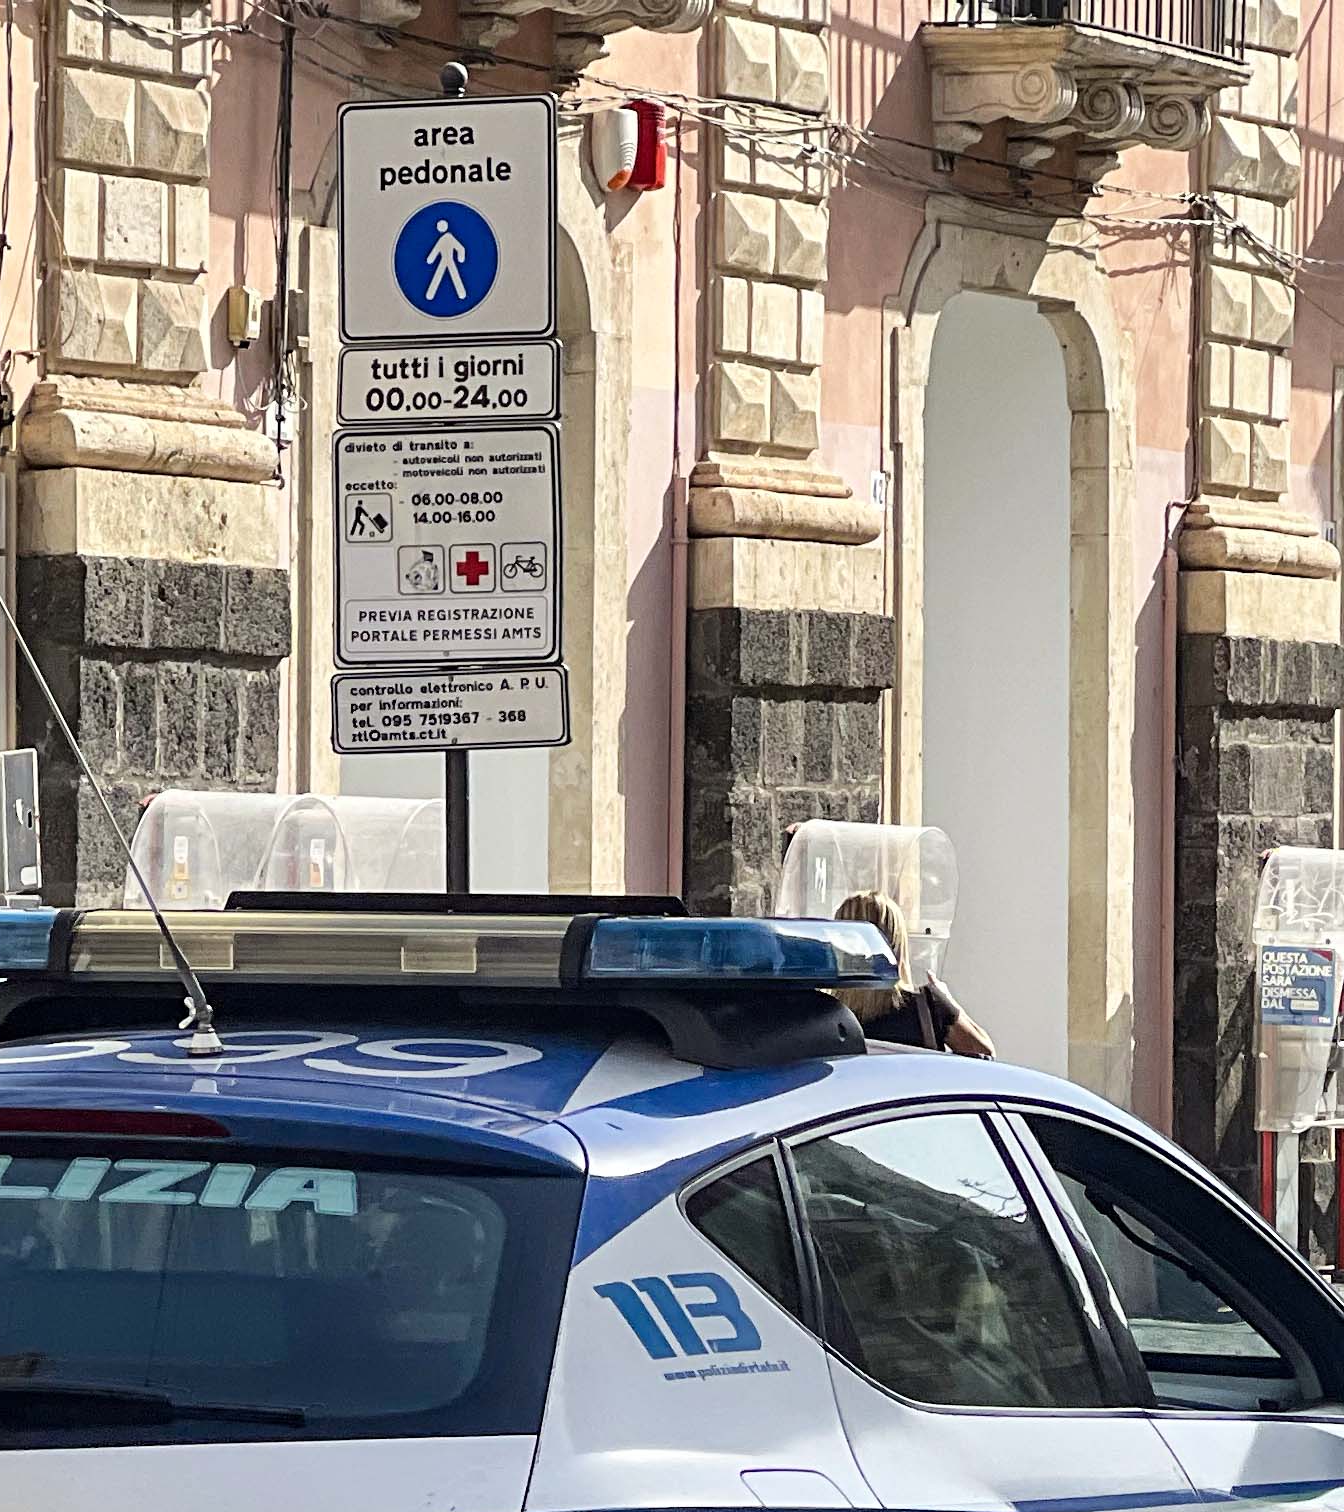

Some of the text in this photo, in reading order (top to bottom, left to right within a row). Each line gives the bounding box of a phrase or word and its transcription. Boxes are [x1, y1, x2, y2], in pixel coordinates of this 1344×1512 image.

[414, 126, 475, 147] area
[380, 157, 512, 191] pedonale
[371, 353, 524, 382] tutti i giorni
[366, 384, 528, 412] 00.00-24.00
[345, 442, 386, 453] divieto
[393, 441, 403, 451] di
[409, 440, 457, 451] transito
[402, 452, 542, 465] autoveicoli non autorizzati
[402, 464, 546, 477] motoveicoli non autorizzati
[345, 481, 397, 491] eccetto:
[411, 491, 503, 506] 06.00-08.00
[413, 509, 495, 524] 14.00-16.00
[359, 607, 535, 622] PREVIA REGISTRAZIONE
[351, 627, 542, 642] PORTALE PERMESSI AMTS
[350, 684, 413, 696] controllo
[420, 681, 493, 694] elettronico
[350, 697, 462, 714] per informazioni:
[352, 709, 527, 728] tel. 095 7519367 368
[1262, 951, 1308, 964] QUESTA
[1262, 963, 1333, 976] POSTAZIONE
[1262, 987, 1317, 999] DISMESSA
[1261, 998, 1285, 1009] DAL
[593, 1272, 762, 1360] 113
